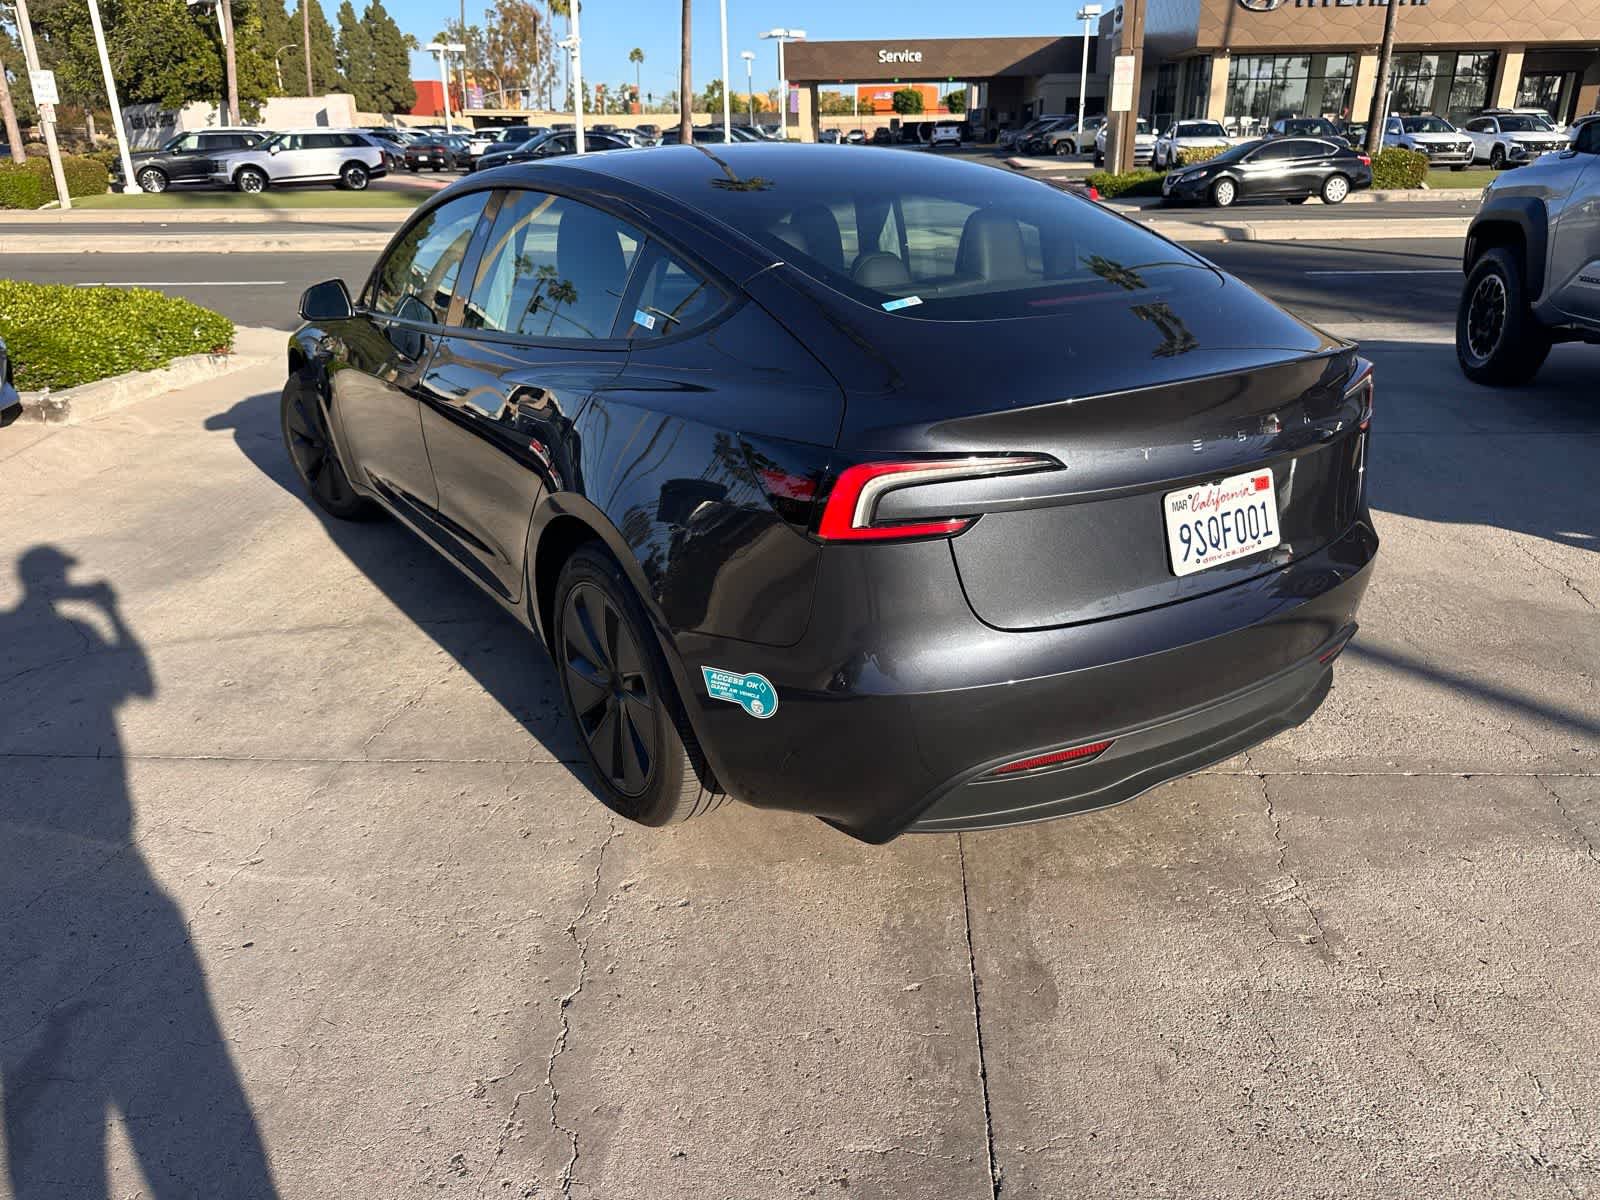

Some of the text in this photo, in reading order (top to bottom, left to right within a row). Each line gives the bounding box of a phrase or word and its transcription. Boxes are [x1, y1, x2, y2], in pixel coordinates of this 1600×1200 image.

[879, 49, 922, 63] Service
[1172, 500, 1188, 513] MAR
[1191, 486, 1256, 513] California
[1180, 501, 1273, 562] 9SQF001
[1202, 544, 1256, 564] dmv.ca.gov
[711, 673, 759, 690] ACCESS OK
[740, 691, 760, 699] VEHICLE
